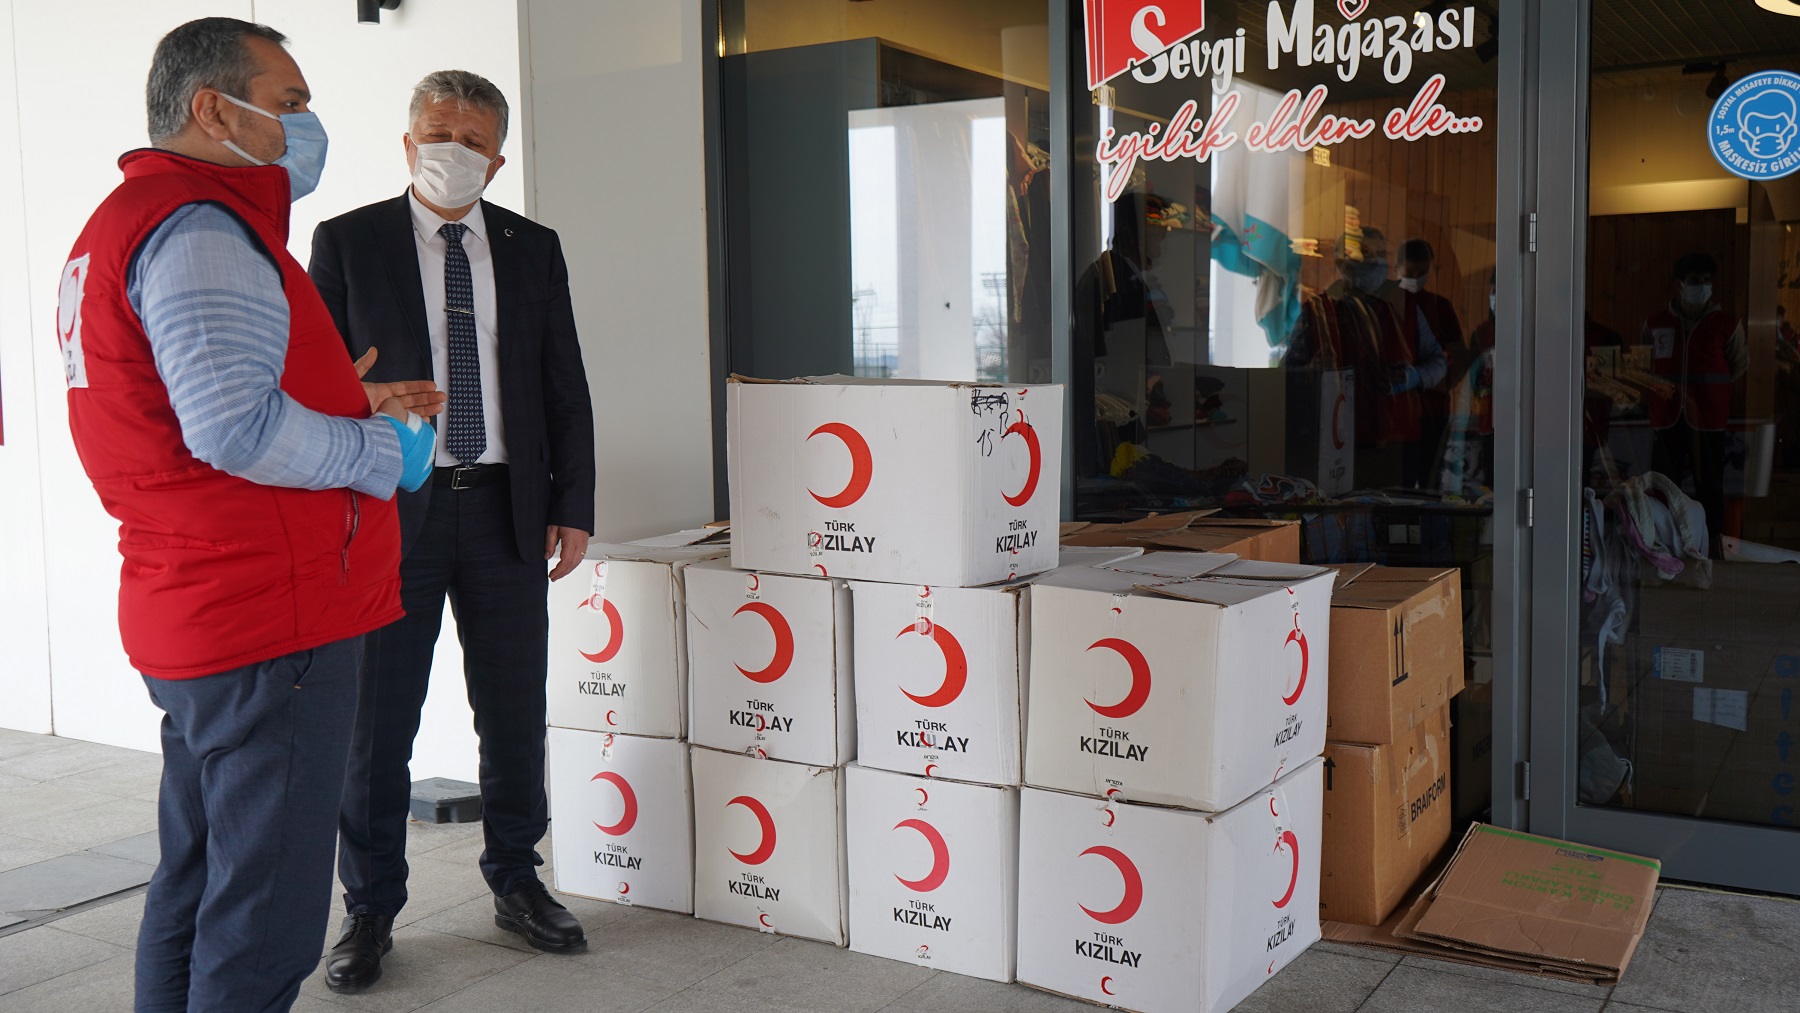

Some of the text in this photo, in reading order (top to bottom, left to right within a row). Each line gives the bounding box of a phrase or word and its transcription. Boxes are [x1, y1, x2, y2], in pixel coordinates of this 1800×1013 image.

[1130, 5, 1246, 95] Sevgi
[1717, 95, 1737, 120] SOSYAL
[1734, 77, 1772, 97] MESAFEYE
[1097, 91, 1240, 202] iyilik
[1246, 84, 1375, 153] elden
[1718, 139, 1800, 174] MASKESİZ GİRİL
[824, 520, 855, 532] TÜRK
[1009, 519, 1028, 531] TÜRK
[996, 530, 1038, 553] KIZILAY
[590, 671, 612, 681] TÜRK
[578, 680, 626, 698] KIZILAY
[746, 699, 775, 712] TÜRK
[915, 719, 948, 732] TÜRK
[1099, 727, 1130, 741] TÜRK
[1274, 720, 1303, 748] KIZILAY
[1080, 735, 1149, 762] KIZILAY
[1411, 772, 1446, 822] BRAIFORM
[606, 842, 628, 855] TÜRK
[593, 851, 642, 871] KIZILAY
[741, 872, 765, 885] TÜRK
[728, 879, 780, 902] KIZILAY
[909, 899, 935, 913] TÜRK
[893, 907, 952, 932] KIZILAY
[1094, 932, 1124, 947] TÜRK
[1266, 919, 1296, 953] KIZILAY
[1075, 939, 1142, 968] KIZILAY
